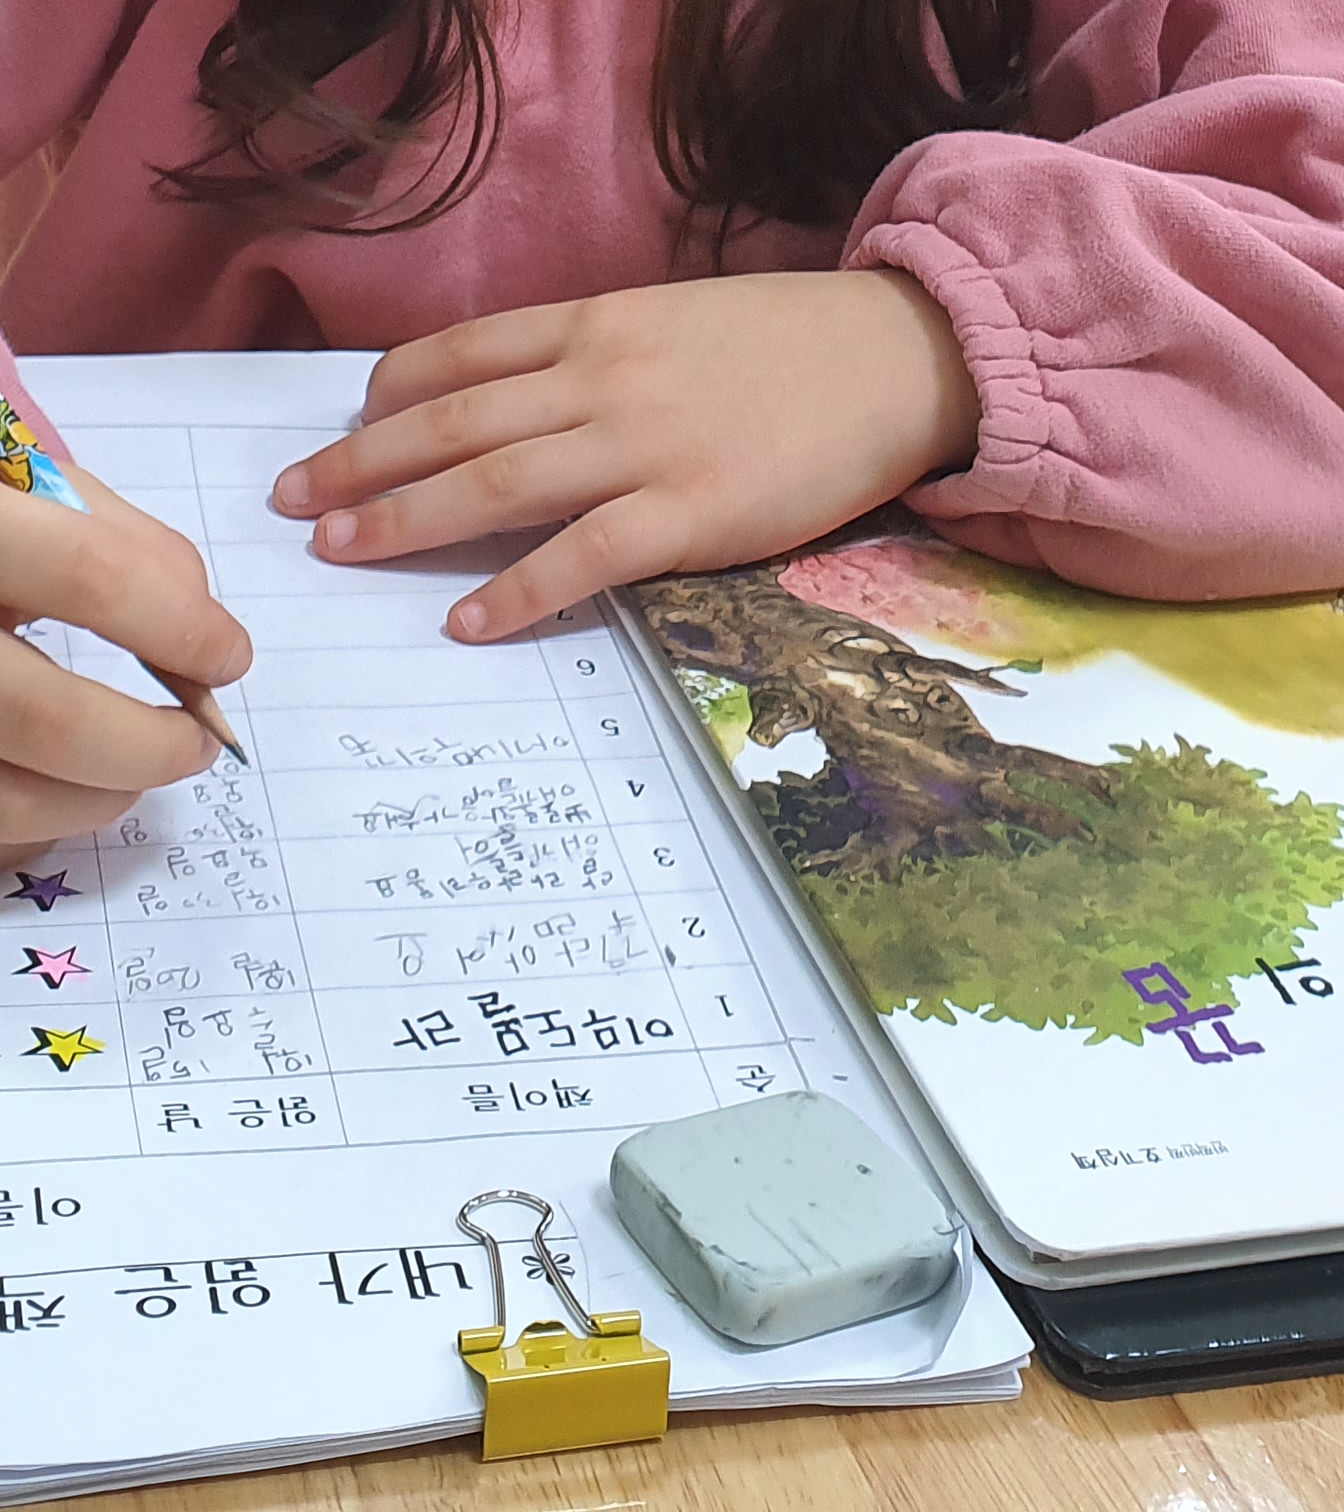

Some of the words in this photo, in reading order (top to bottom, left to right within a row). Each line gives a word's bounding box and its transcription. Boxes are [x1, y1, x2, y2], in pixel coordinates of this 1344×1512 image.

[576, 658, 595, 676] 6
[599, 717, 619, 737] 5
[625, 777, 645, 797] 4
[653, 847, 674, 867] 3
[681, 917, 705, 938] 2
[713, 995, 735, 1017] 1
[1121, 961, 1266, 1066] 꿈
[735, 1064, 776, 1094] 순
[461, 1078, 593, 1114] 책이름
[157, 1102, 202, 1133] 날
[228, 1096, 316, 1128] 읽은
[1069, 1146, 1162, 1171] 호기심책
[113, 1259, 271, 1319] 읽은
[316, 1249, 473, 1306] 내가
